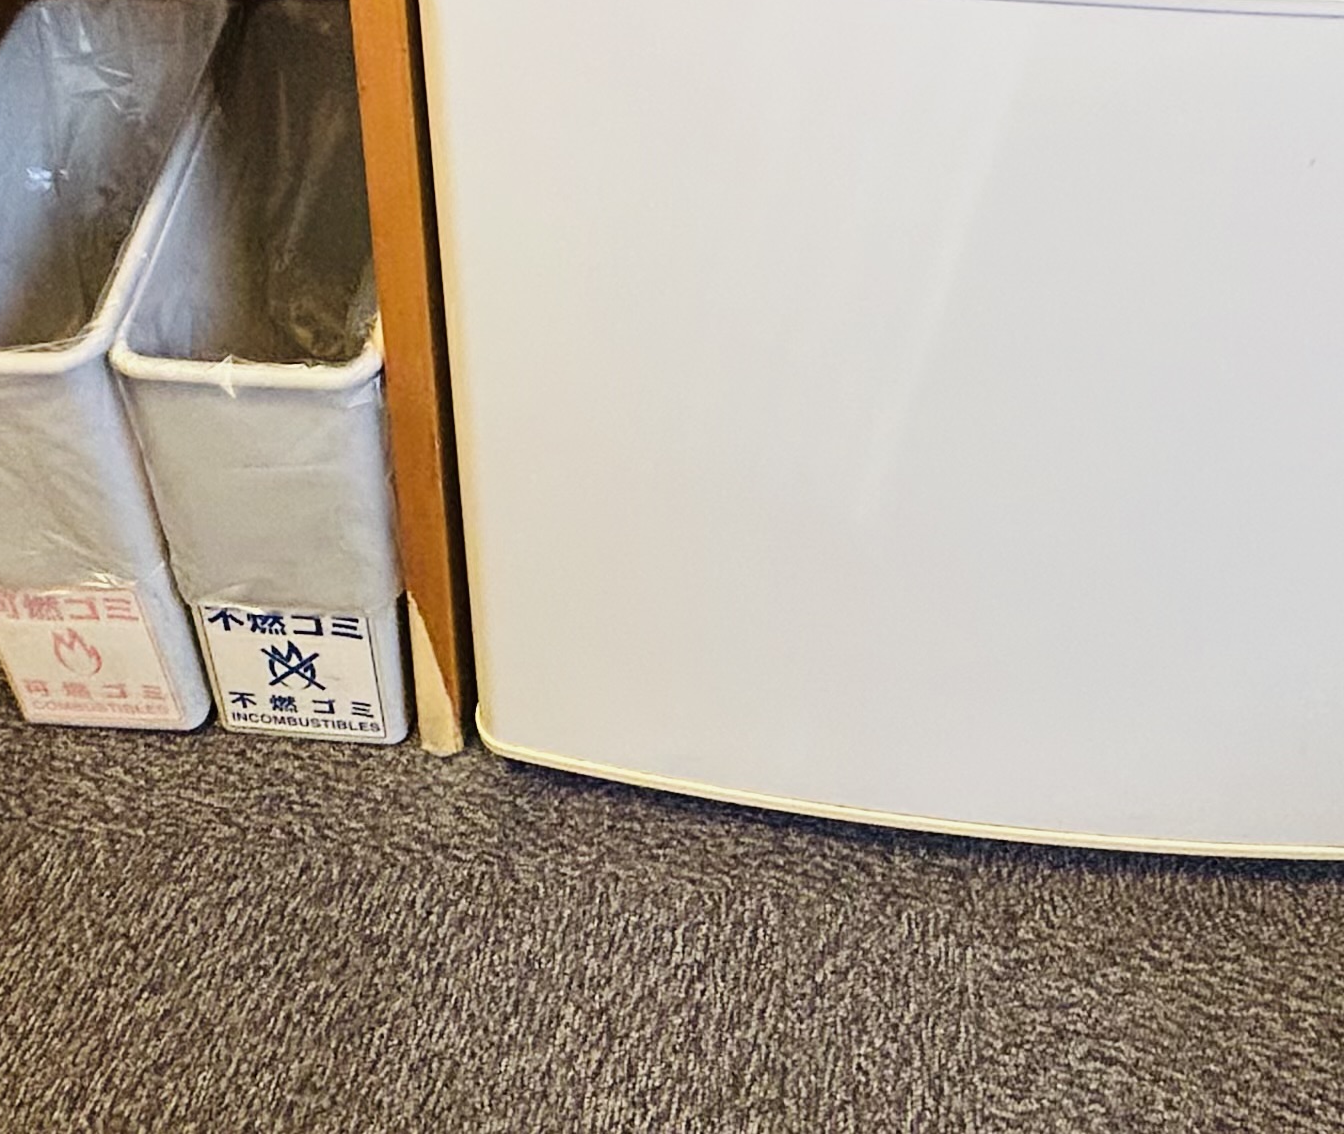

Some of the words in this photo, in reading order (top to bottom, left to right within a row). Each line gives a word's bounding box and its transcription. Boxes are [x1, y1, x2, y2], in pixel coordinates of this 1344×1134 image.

[229, 691, 375, 719] 不燃ゴミ
[232, 711, 382, 733] INCOMBUSTIBLES
